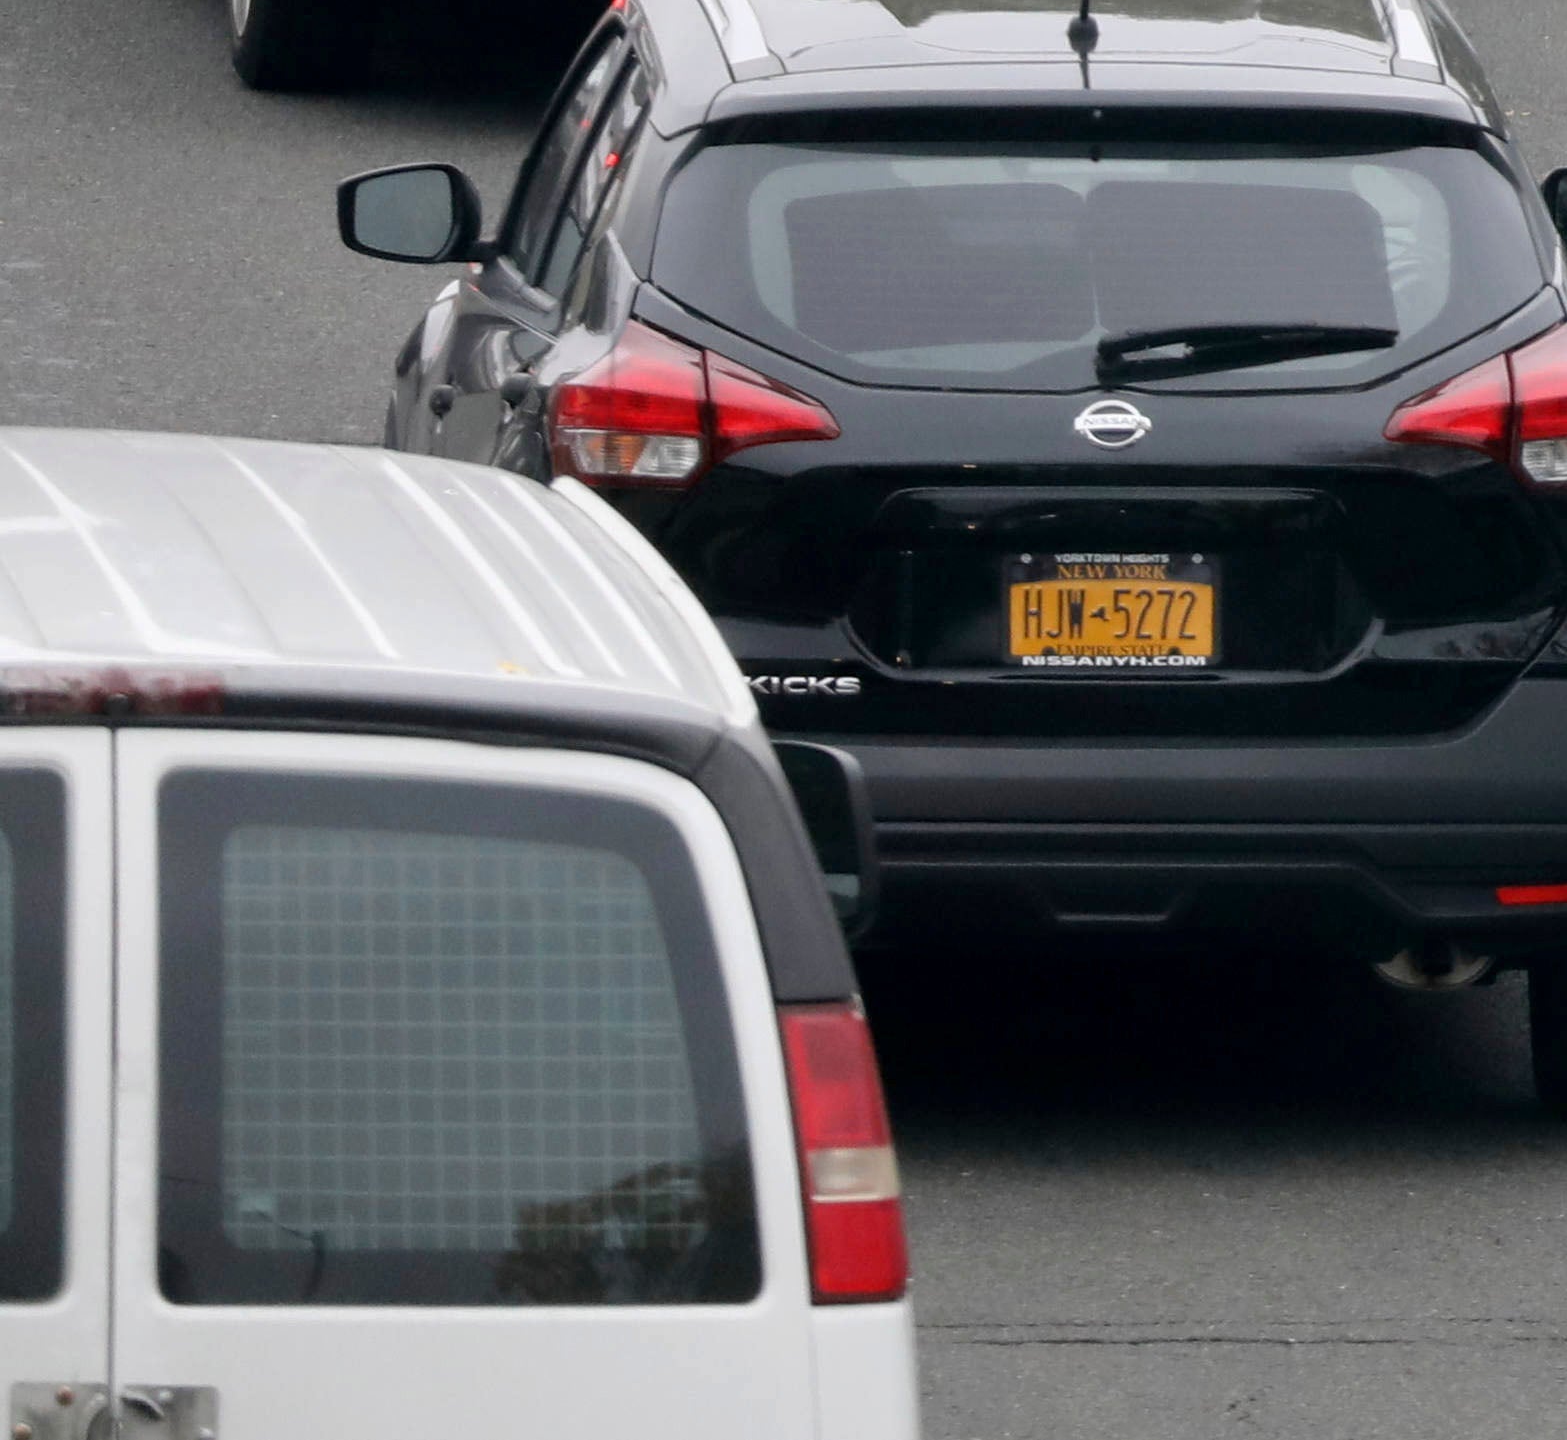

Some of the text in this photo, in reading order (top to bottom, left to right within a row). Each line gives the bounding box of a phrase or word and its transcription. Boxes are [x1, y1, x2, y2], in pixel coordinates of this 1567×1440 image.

[1054, 554, 1170, 564] YORKTOWN HEIGHTS
[1057, 565, 1167, 579] NEW YORK
[1022, 656, 1206, 666] NISSANYH.COM
[744, 676, 861, 694] KICKS
